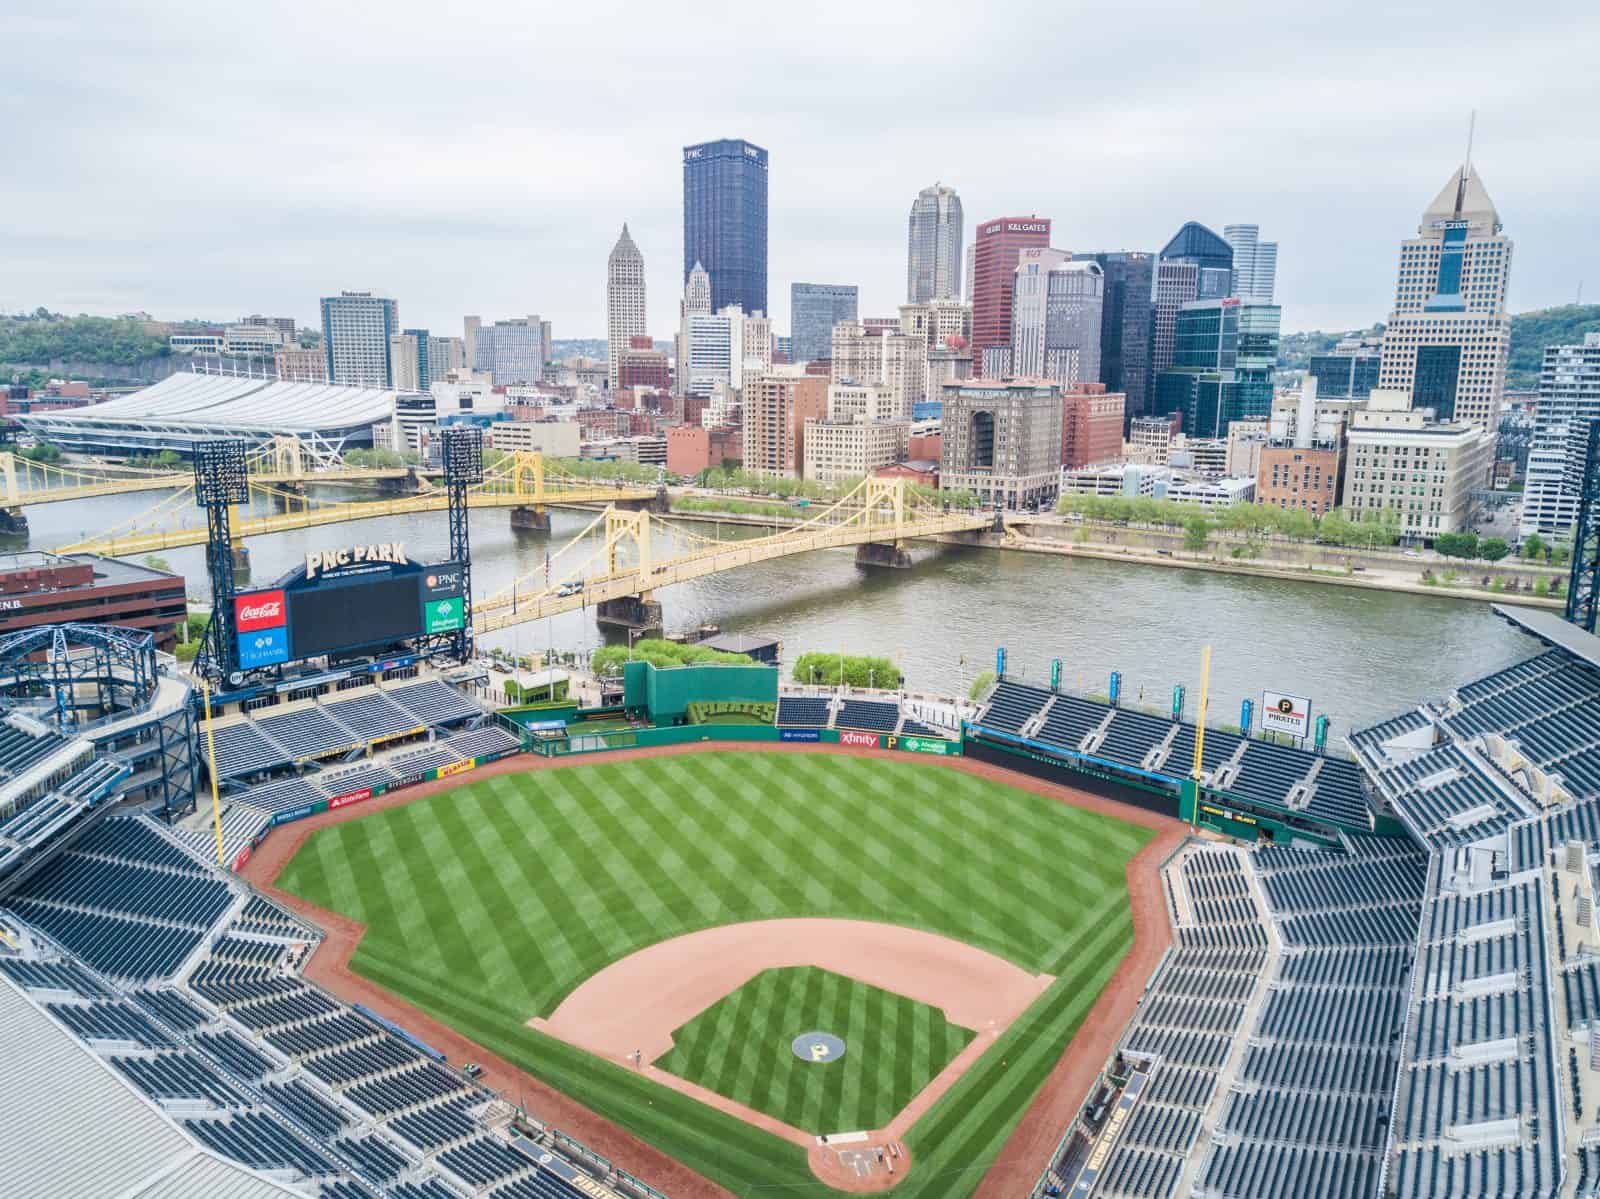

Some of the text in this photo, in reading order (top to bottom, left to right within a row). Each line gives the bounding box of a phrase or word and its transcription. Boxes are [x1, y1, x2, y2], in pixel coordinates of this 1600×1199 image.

[1022, 224, 1047, 233] GATES
[304, 549, 351, 580] PNC
[352, 543, 409, 566] PARK
[437, 572, 460, 585] PNC
[696, 702, 777, 722] PIRATES
[841, 731, 878, 747] xfinity
[887, 736, 896, 748] P
